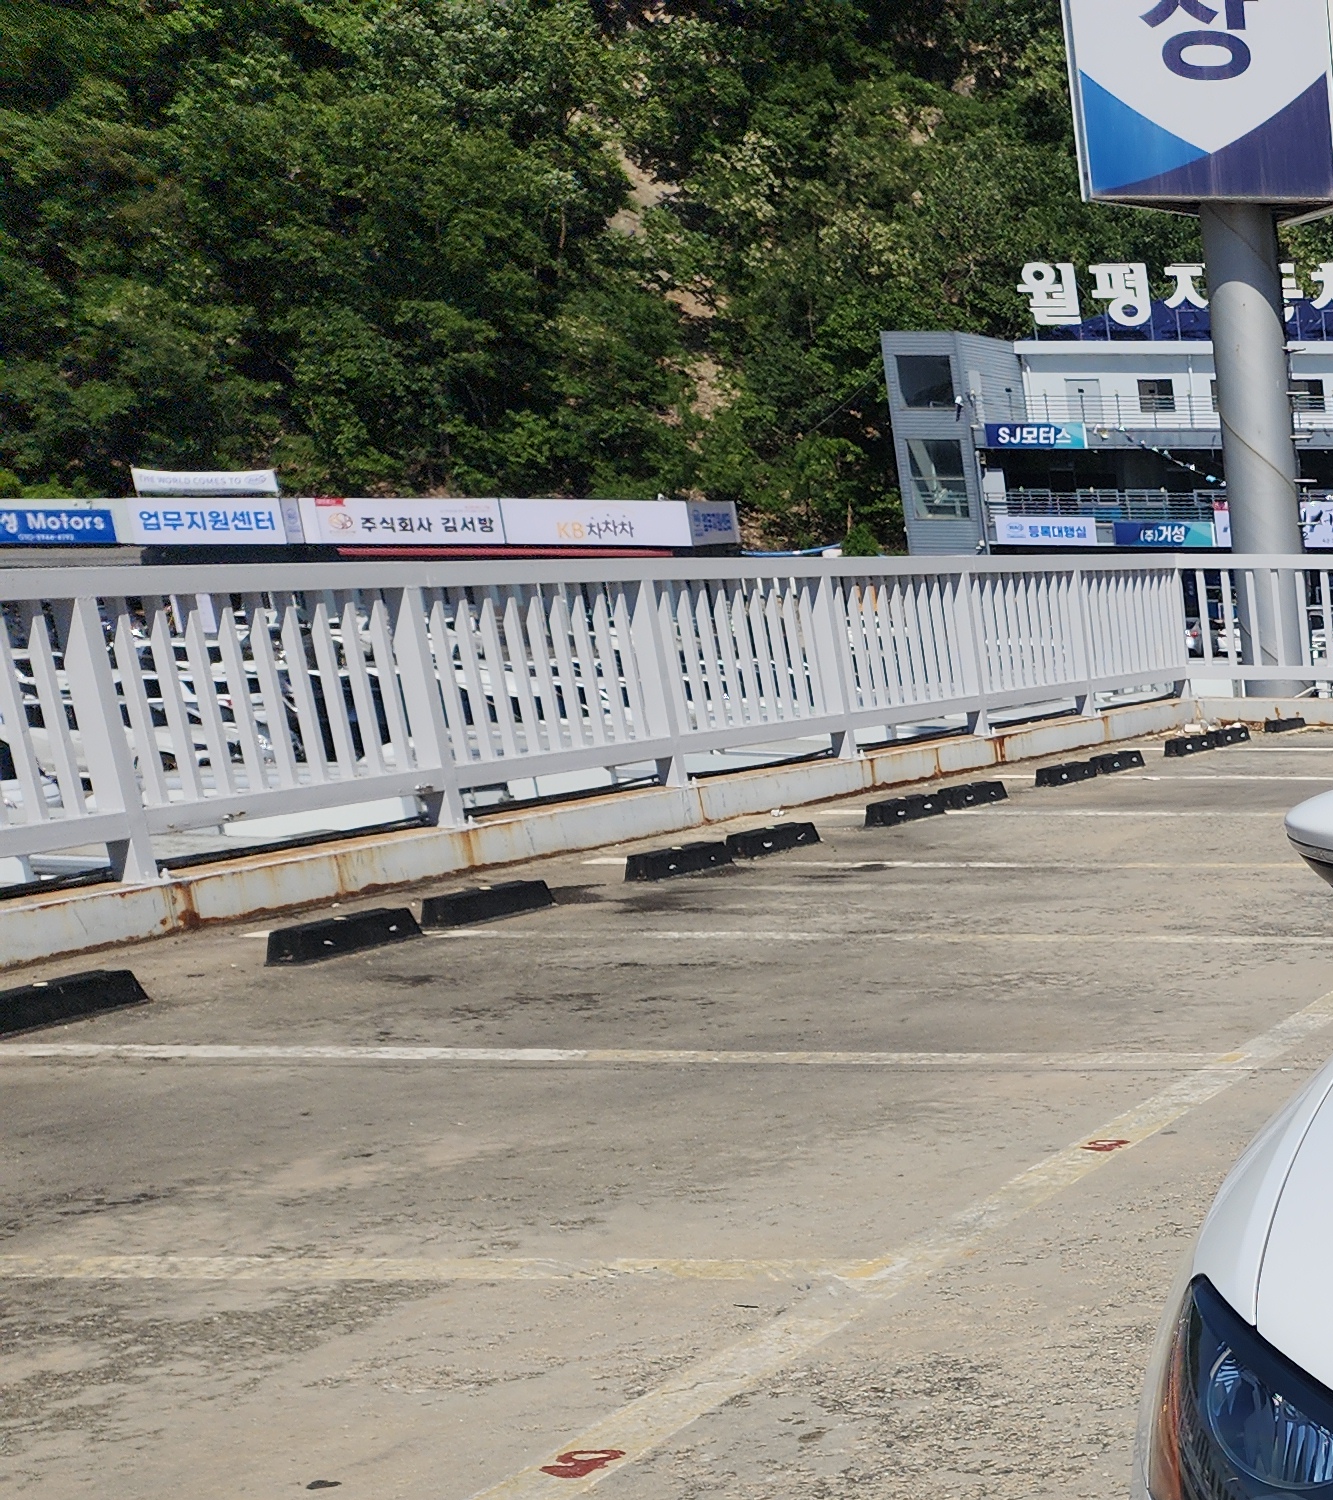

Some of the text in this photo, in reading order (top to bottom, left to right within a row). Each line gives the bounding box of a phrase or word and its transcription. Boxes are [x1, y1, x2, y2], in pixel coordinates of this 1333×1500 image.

[997, 427, 1072, 445] SJ모터스
[25, 511, 105, 531] Motors
[139, 510, 275, 532] 업무지원센터
[361, 516, 494, 533] 주식회사 김서방
[1140, 525, 1186, 543] (주)거성
